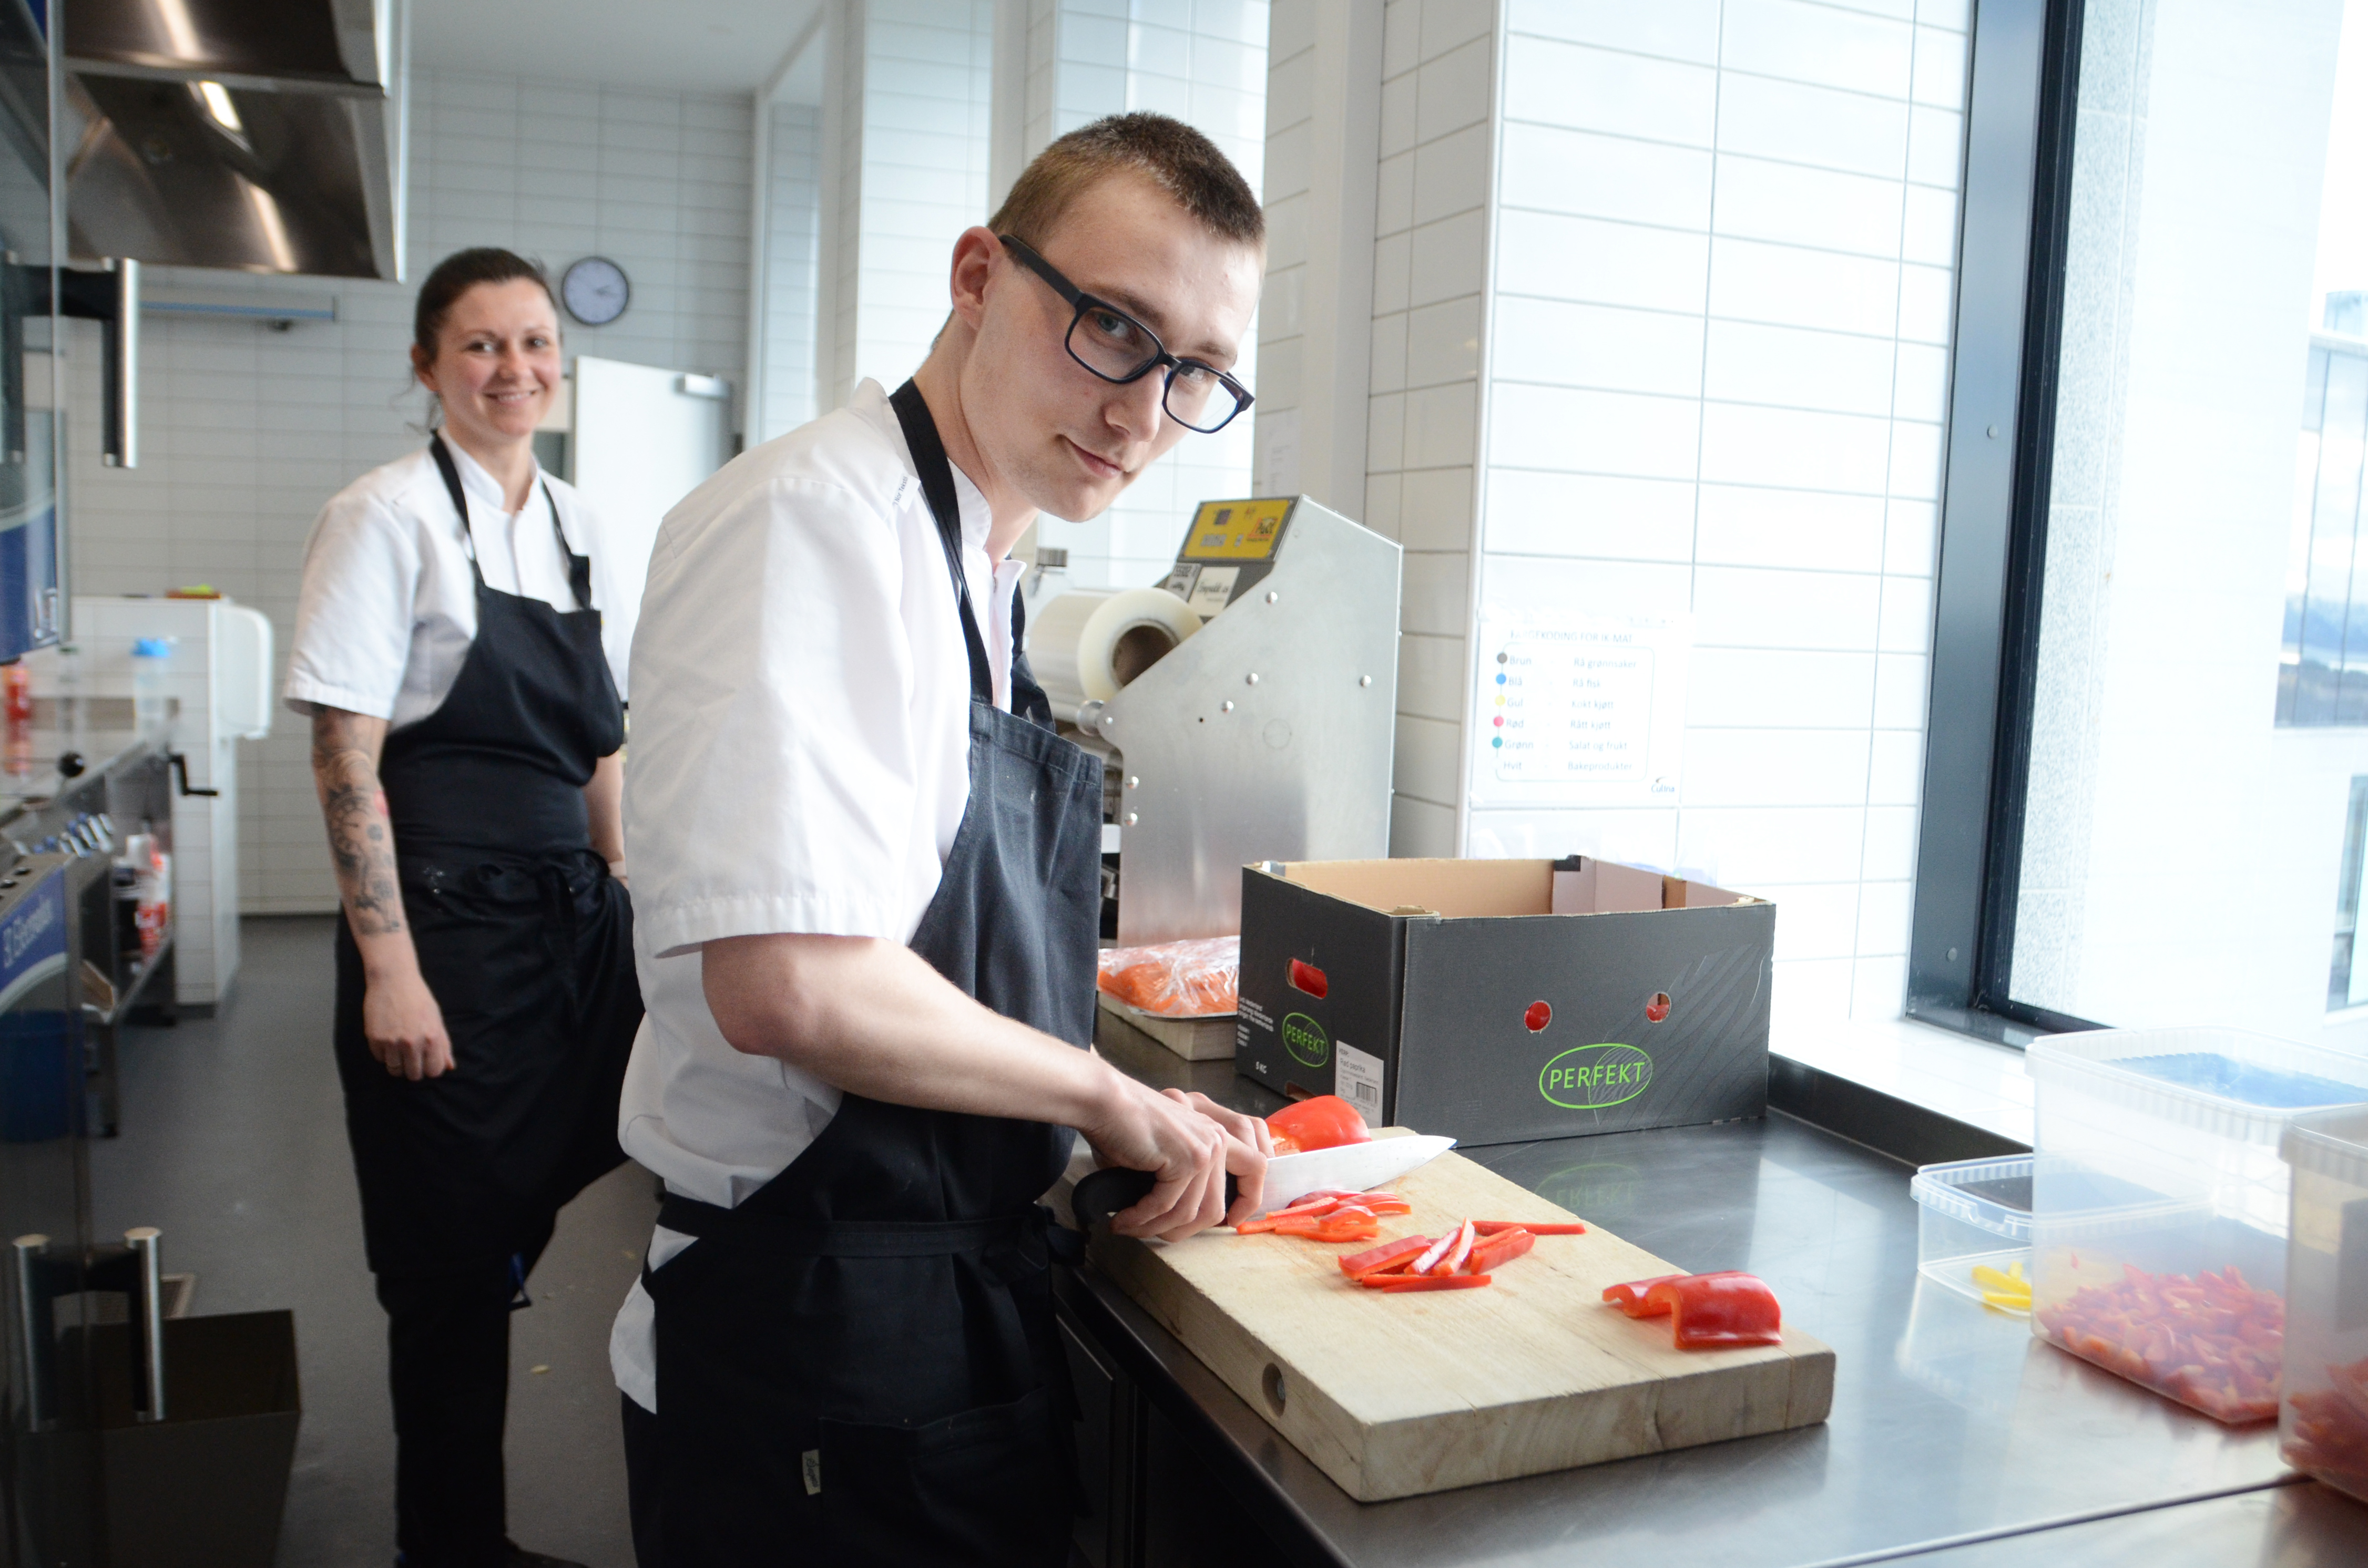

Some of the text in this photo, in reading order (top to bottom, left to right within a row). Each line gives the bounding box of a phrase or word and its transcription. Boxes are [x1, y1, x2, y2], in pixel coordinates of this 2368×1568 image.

[899, 476, 909, 491] Tekstil
[1580, 632, 1598, 642] FOR
[1601, 633, 1633, 643] IK-MAT
[1509, 655, 1637, 669] Brun Rå grønnsaker
[1508, 676, 1601, 688] Blå Rå fisk
[1507, 697, 1614, 711] Gul Kokt kjøtt
[1506, 719, 1611, 731] Rød Rått kjøtt
[1505, 740, 1628, 752] Grønn Salat og frukt
[1503, 761, 1632, 772] Hvit Bakeprodukter
[1286, 1024, 1325, 1055] PERFEKT
[1260, 1063, 1268, 1074] KG
[1549, 1061, 1645, 1090] PERFEKT
